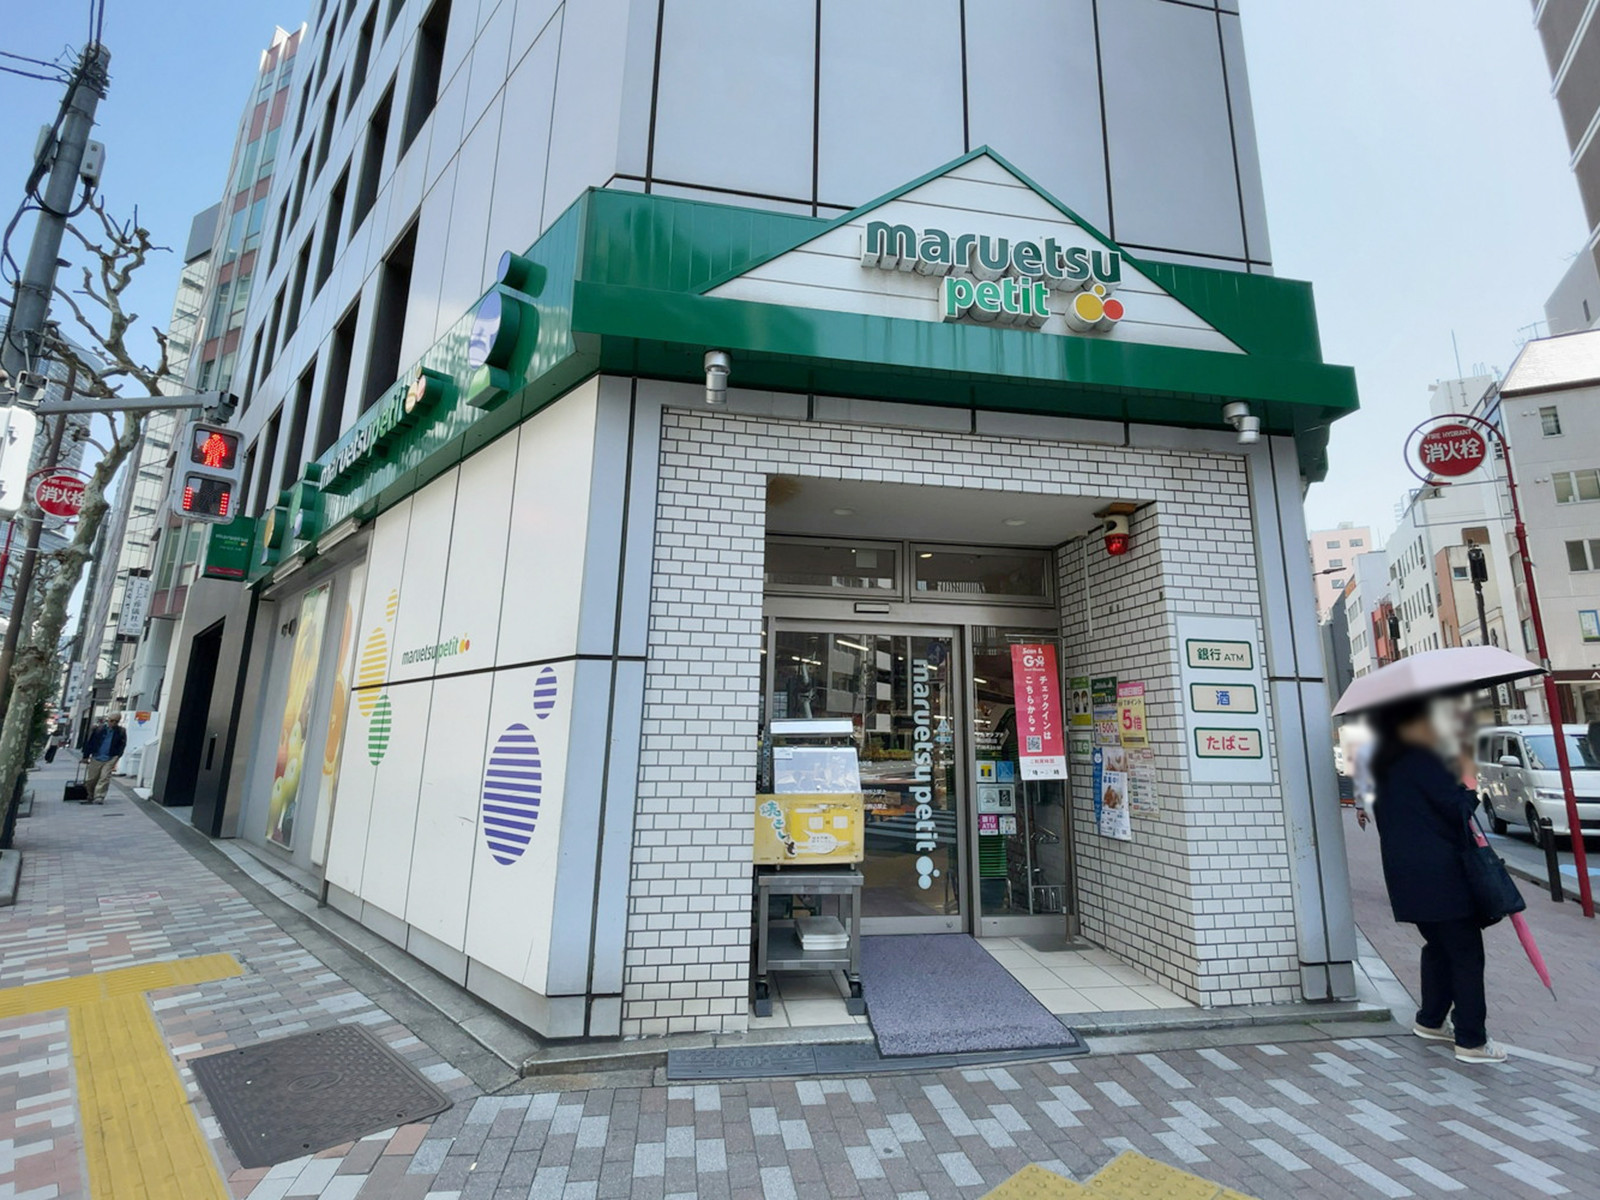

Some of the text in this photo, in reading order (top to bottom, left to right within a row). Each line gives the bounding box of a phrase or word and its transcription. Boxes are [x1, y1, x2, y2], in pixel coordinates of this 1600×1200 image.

[864, 220, 1122, 285] maruetsu
[945, 276, 1051, 318] petit
[1423, 437, 1482, 464] 消火栓
[1197, 647, 1244, 662] 銀行 ATM
[1025, 675, 1036, 725] こちらから
[1039, 675, 1052, 740] チェックインは
[1216, 690, 1230, 706] 酒
[1206, 735, 1250, 751] たばこ
